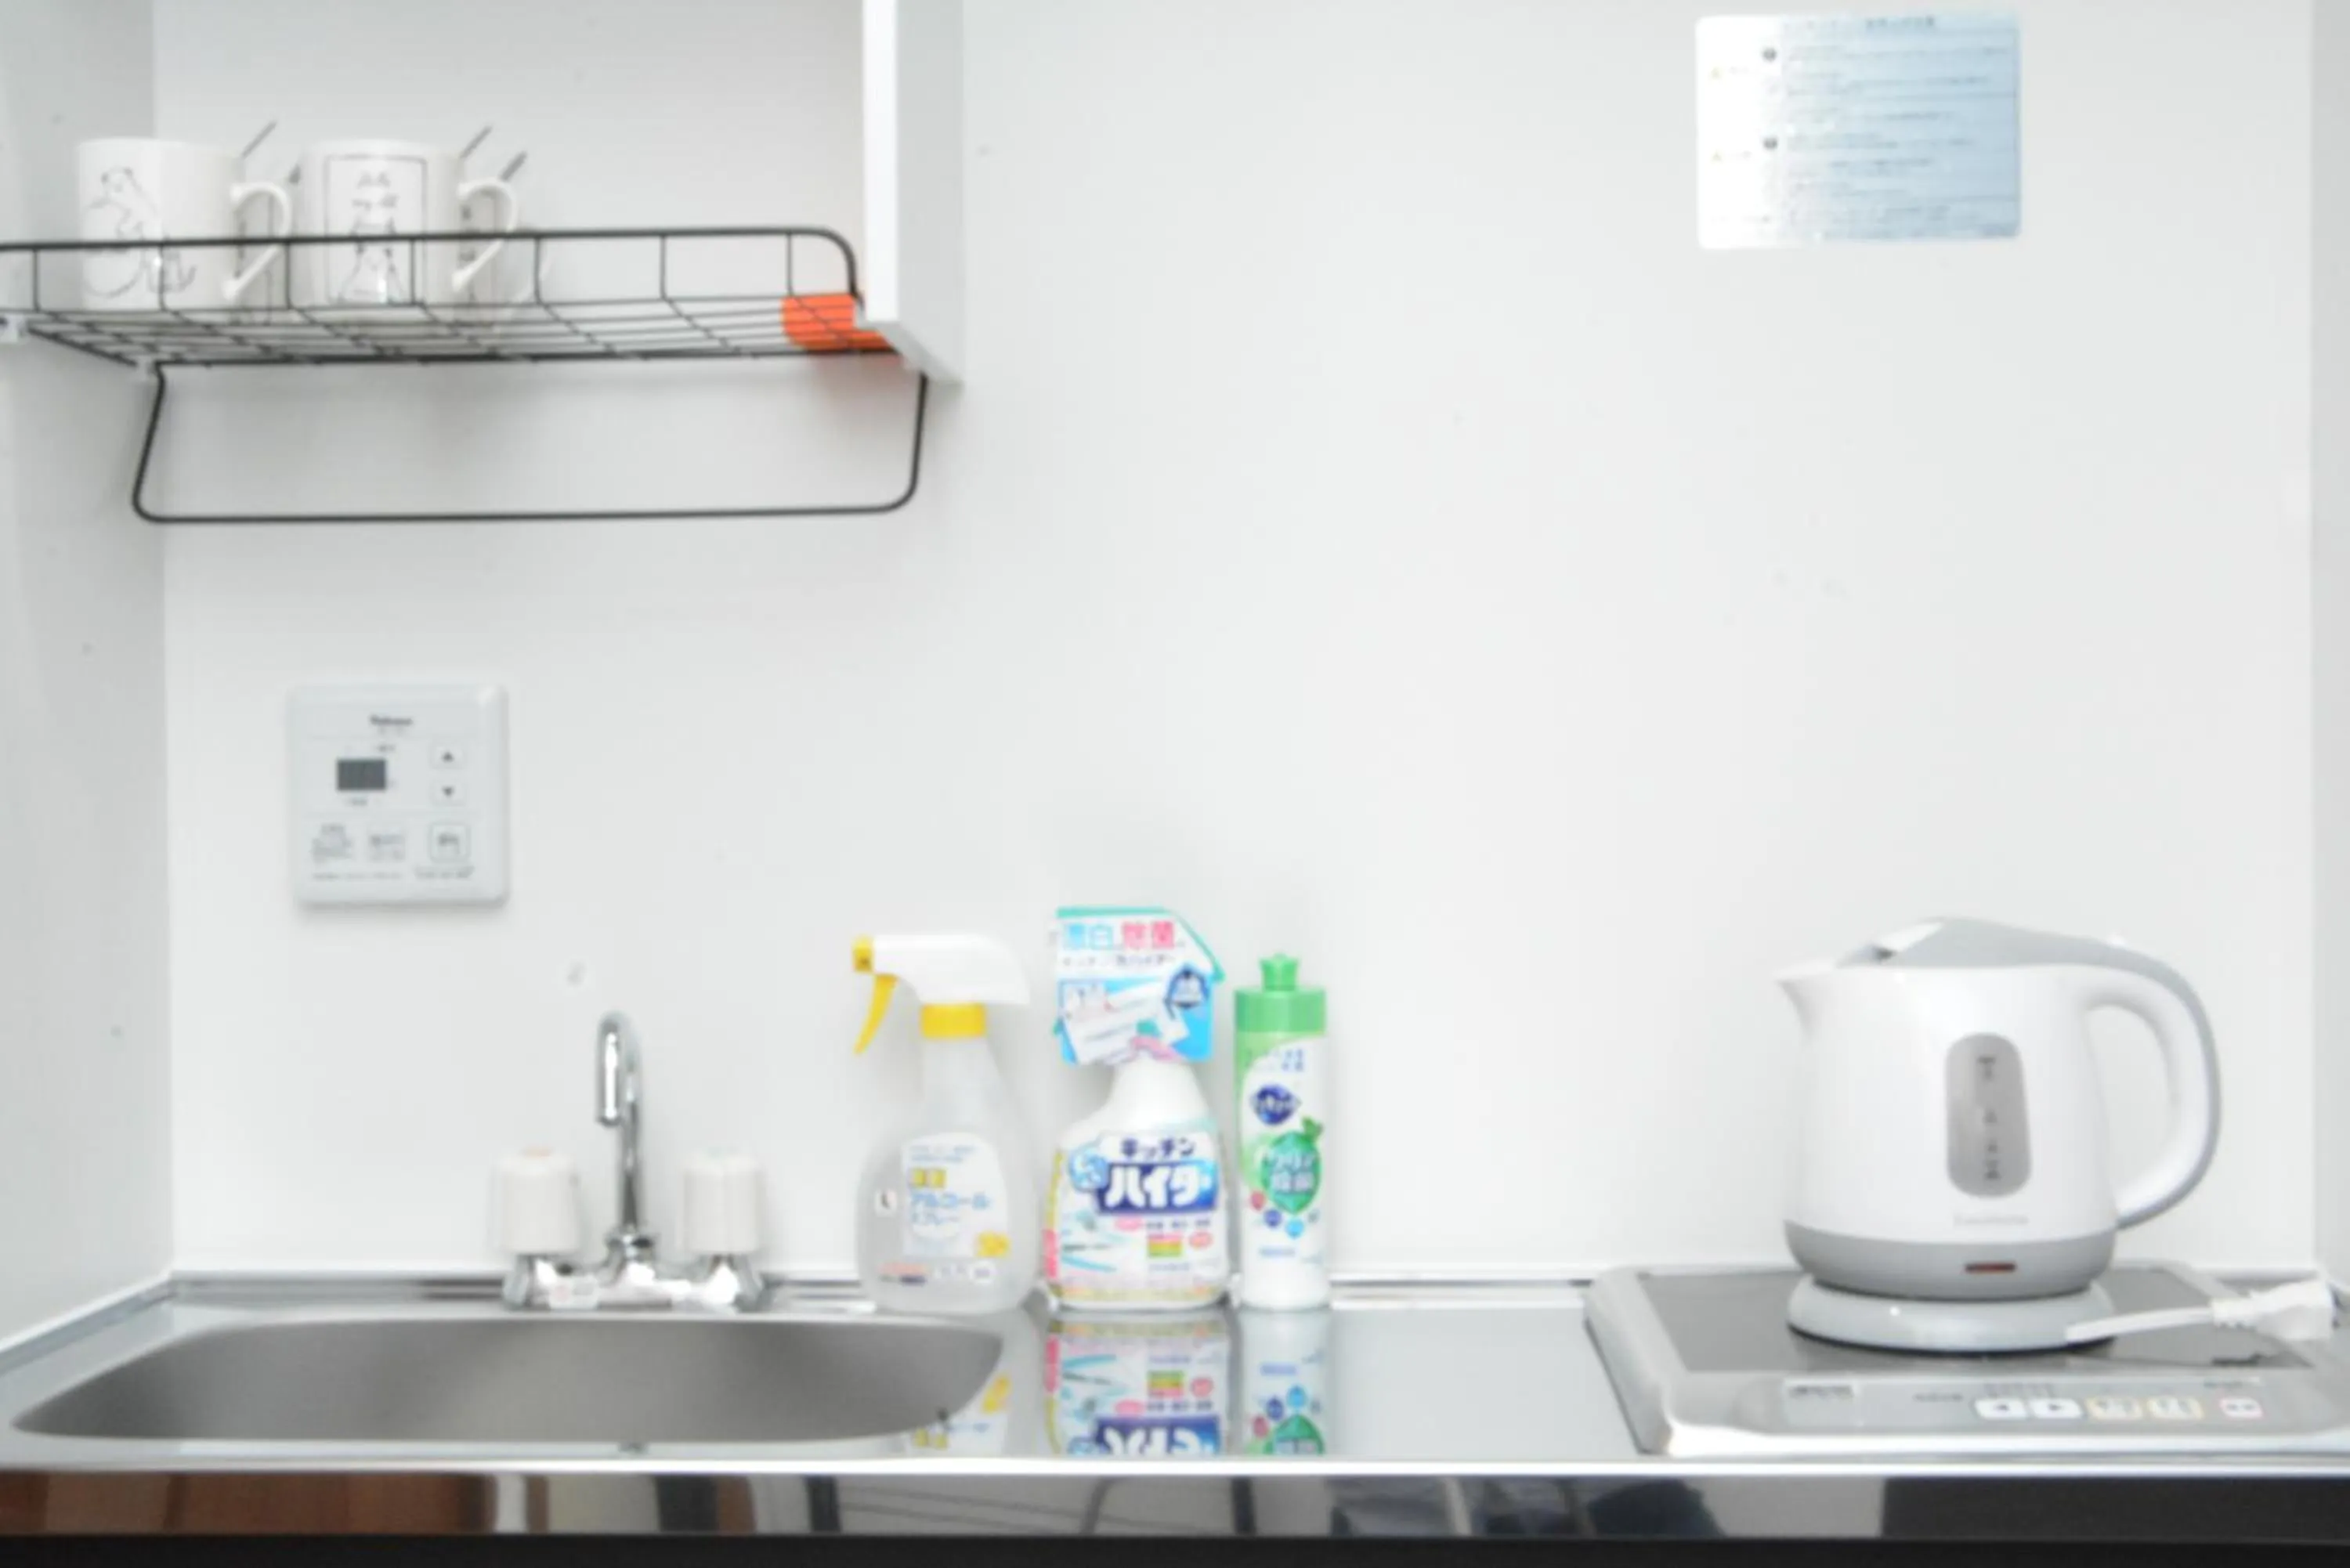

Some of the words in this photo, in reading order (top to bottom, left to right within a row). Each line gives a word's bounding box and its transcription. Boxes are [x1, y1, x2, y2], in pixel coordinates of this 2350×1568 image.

[1119, 1138, 1195, 1157] キッチン
[1104, 1165, 1213, 1207] ハイター
